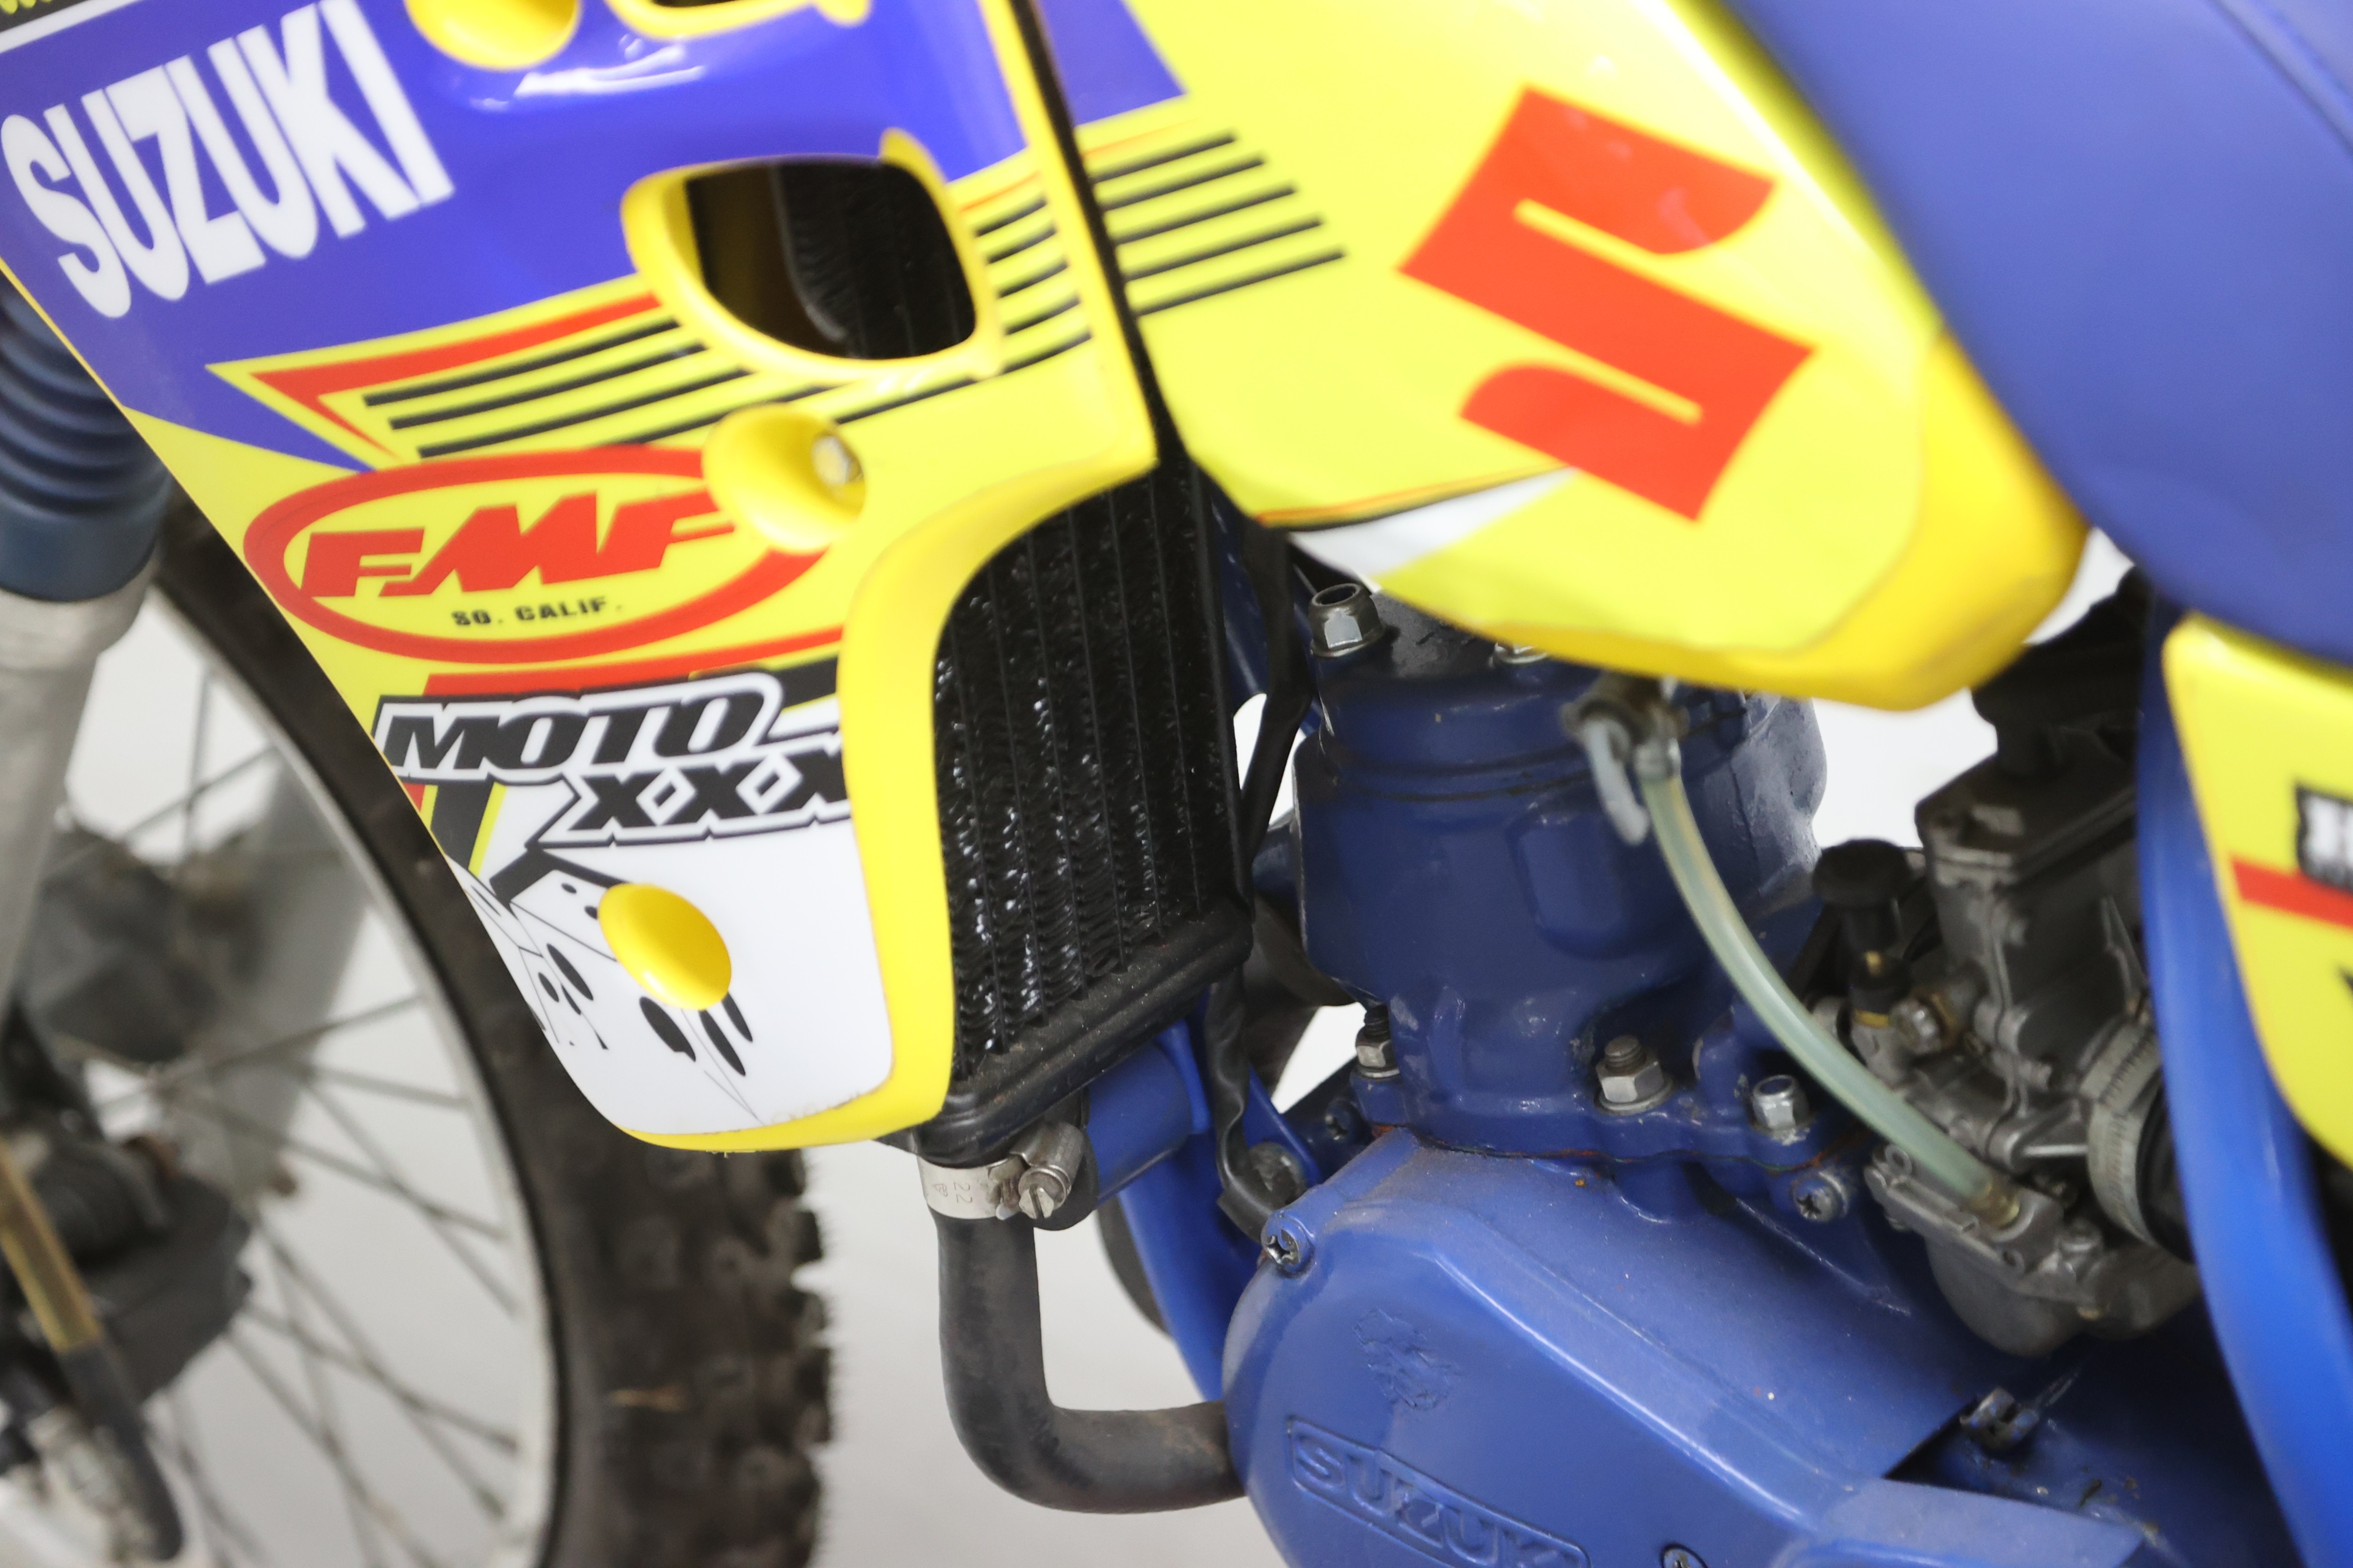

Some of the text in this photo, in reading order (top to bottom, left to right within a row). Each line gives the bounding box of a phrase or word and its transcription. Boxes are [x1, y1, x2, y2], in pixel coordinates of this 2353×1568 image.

[1, 0, 455, 318] SUZUKI
[301, 491, 735, 597] FMF
[382, 690, 767, 770] MOTO
[1295, 1433, 1582, 1567] SUZUK
